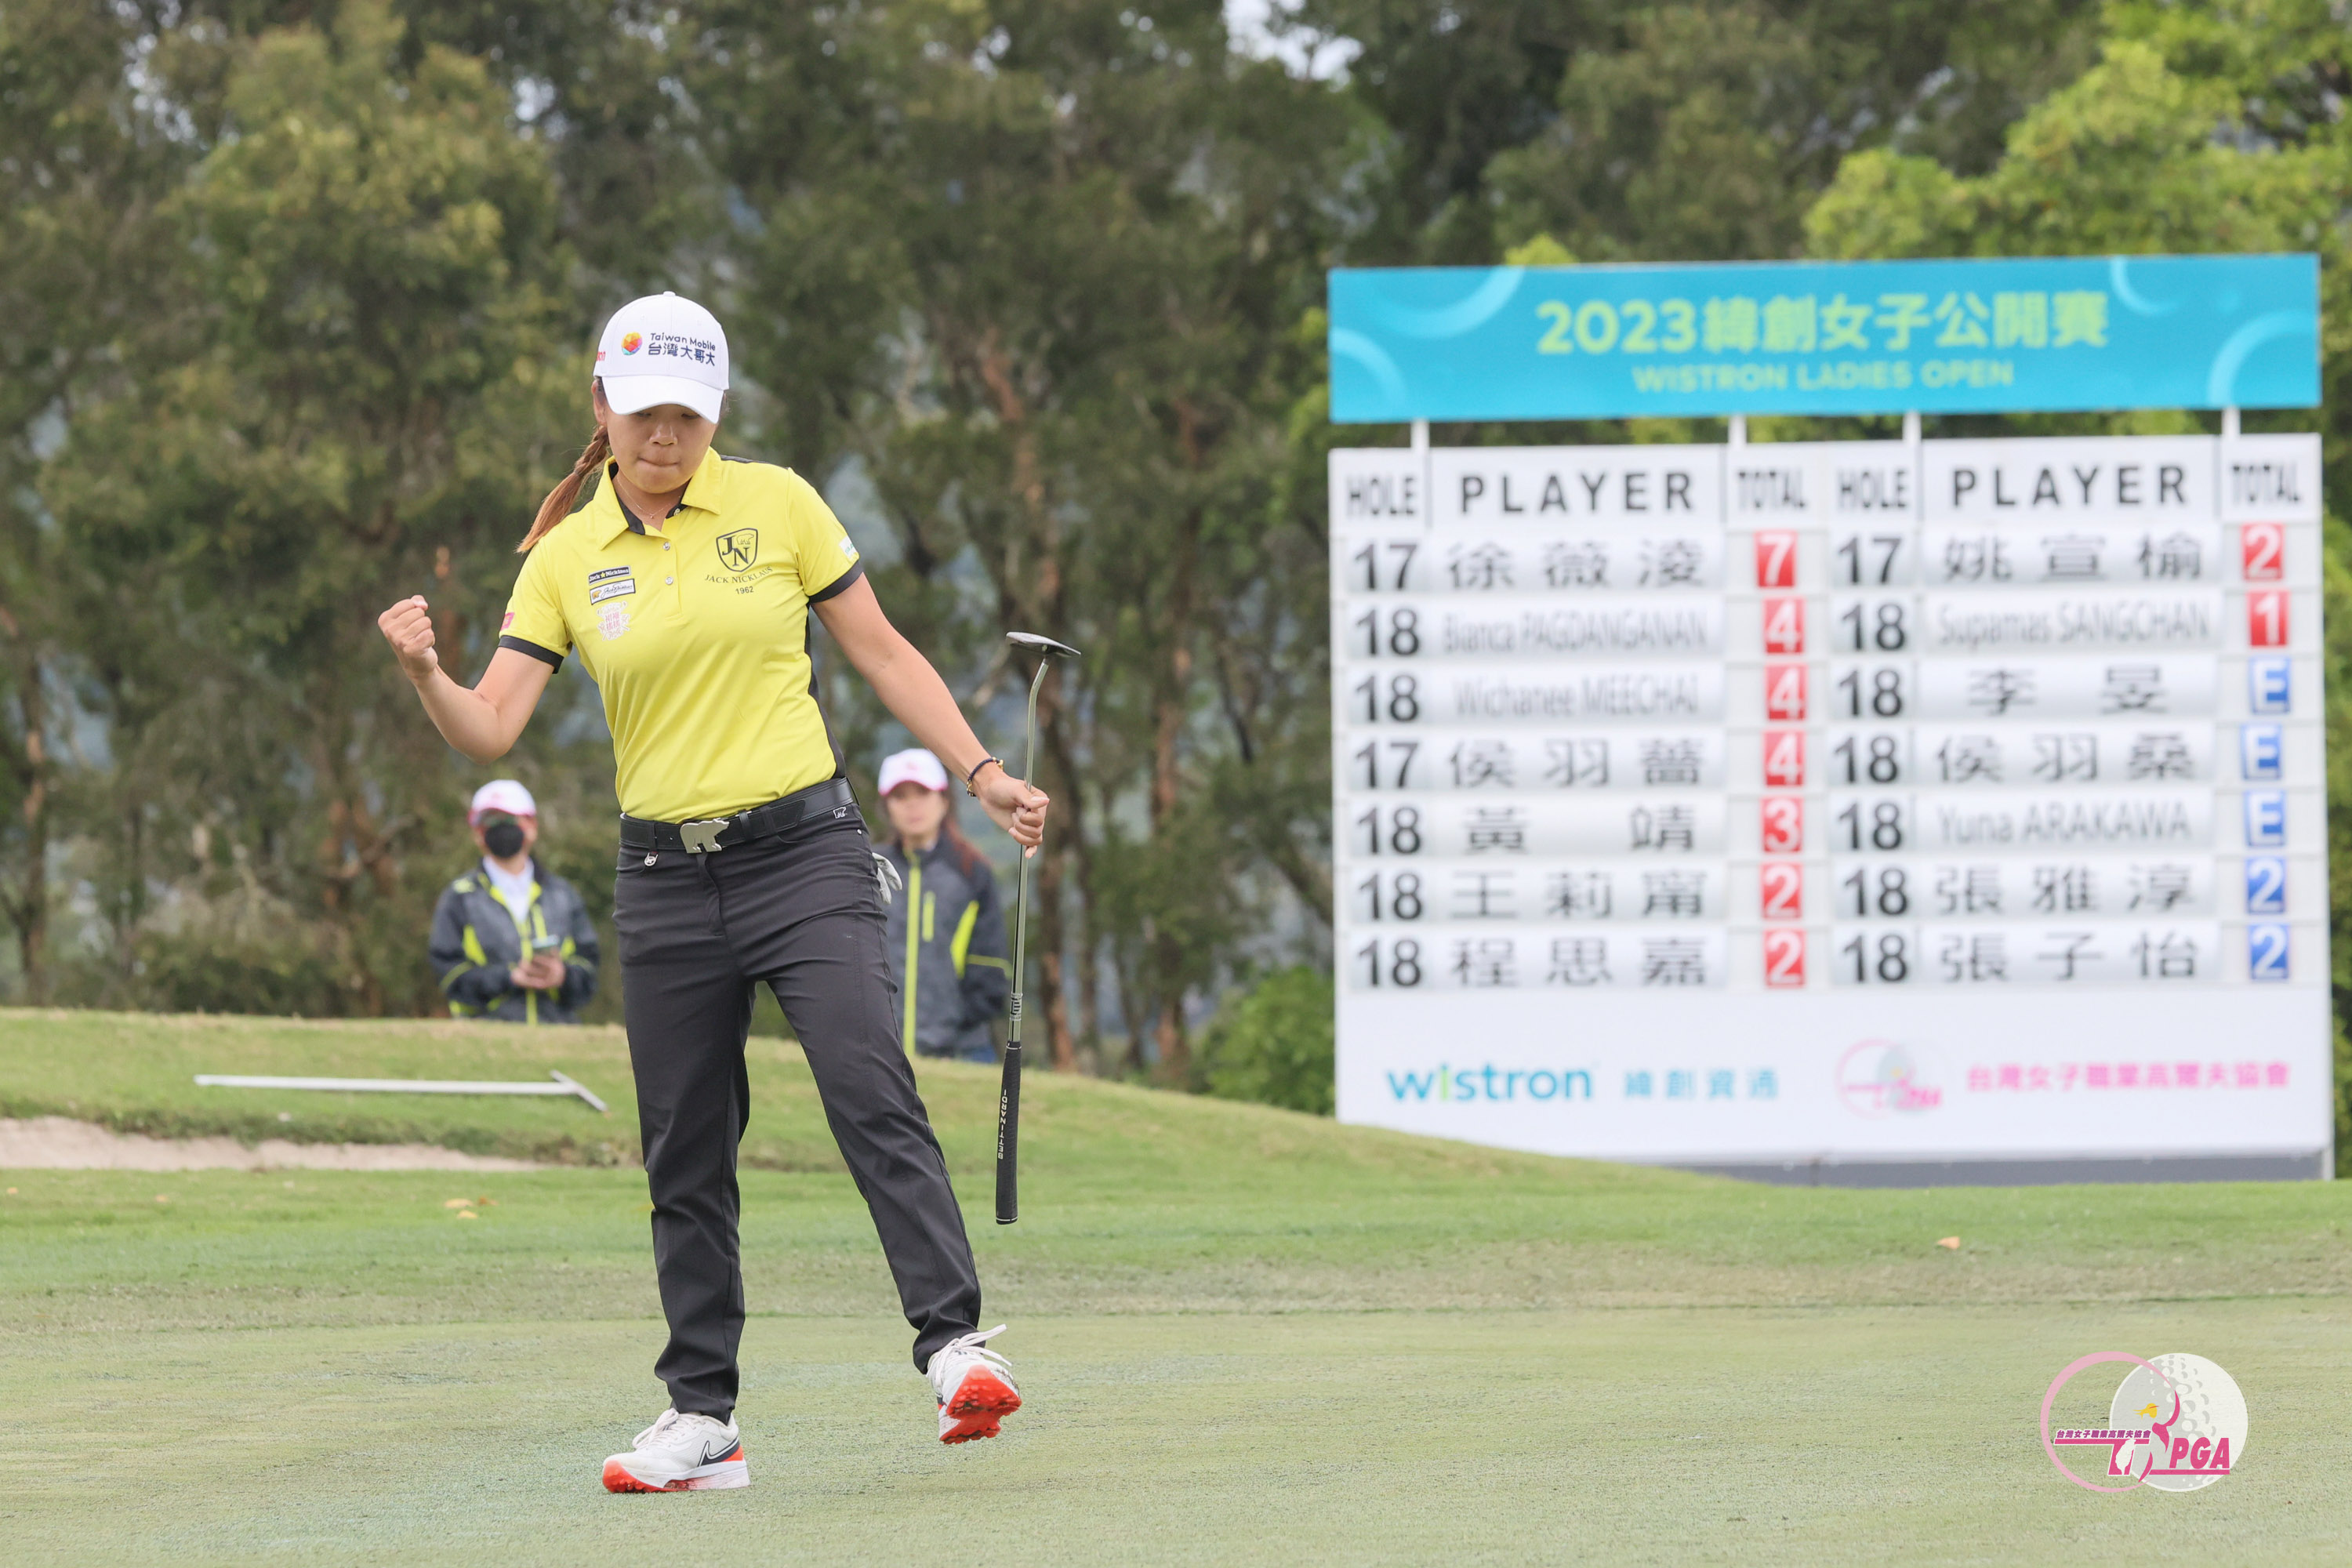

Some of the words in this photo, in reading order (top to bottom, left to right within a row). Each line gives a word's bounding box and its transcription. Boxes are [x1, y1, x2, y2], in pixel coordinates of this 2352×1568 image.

[648, 343, 715, 366] 台灣大哥大
[651, 332, 687, 343] Taiwan
[690, 337, 715, 350] Mobile
[1632, 363, 1788, 392] WISTRON
[1796, 361, 1913, 390] LADIES
[1921, 358, 2014, 389] OPEN
[1348, 474, 1415, 517] HOLE
[1461, 470, 1693, 516] PLAYER
[1737, 469, 1809, 512] TOTAL
[1839, 468, 1907, 511] HOLE
[1952, 464, 2187, 510] PLAYER
[2231, 462, 2302, 505] TOTAL
[705, 574, 729, 583] JACK
[731, 566, 773, 583] NICKLAUS
[1356, 544, 1417, 591] 17
[1760, 532, 1792, 586] 7
[1839, 538, 1903, 586] 17
[2245, 524, 2280, 579] 2
[735, 586, 754, 594] 1962
[1357, 609, 1421, 657] 18
[1766, 600, 1800, 653] 4
[1842, 604, 1907, 652] 18
[2255, 592, 2279, 645] 1
[1357, 676, 1420, 724] 18
[1769, 666, 1802, 719] 4
[1841, 670, 1904, 719] 18
[2253, 659, 2288, 712] E
[1356, 742, 1419, 789] 17
[1766, 733, 1802, 785] 4
[1835, 736, 1899, 785] 18
[2244, 726, 2280, 779] E
[1358, 807, 1422, 855] 18
[1764, 798, 1800, 851] 3
[1840, 803, 1903, 851] 18
[1936, 803, 2015, 844] Yuna
[2023, 800, 2192, 844] ARAKAWA
[2247, 791, 2284, 845] E
[1359, 873, 1424, 921] 18
[1765, 864, 1800, 919] 2
[1845, 869, 1910, 917] 18
[2248, 858, 2285, 913] 2
[1359, 939, 1423, 988] 18
[1769, 931, 1802, 986] 2
[1845, 935, 1910, 983] 18
[2250, 924, 2288, 978] 2
[1386, 1062, 1592, 1101] wistron
[997, 1089, 1008, 1160] BETTINARDI
